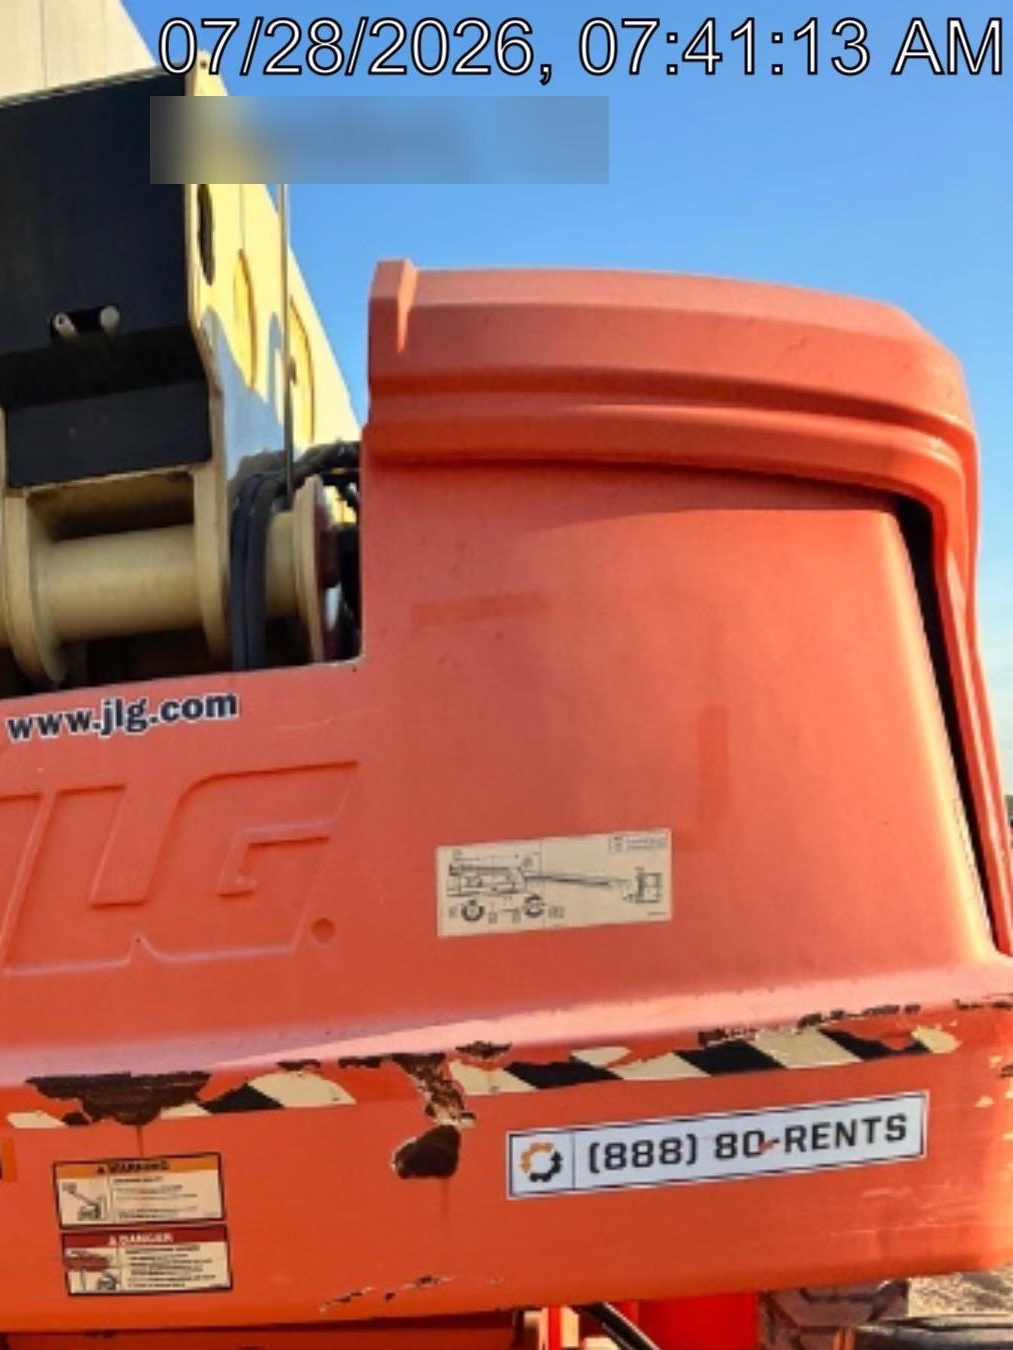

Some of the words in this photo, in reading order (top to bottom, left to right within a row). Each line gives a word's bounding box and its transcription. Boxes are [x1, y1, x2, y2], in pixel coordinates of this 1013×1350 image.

[6, 693, 239, 742] www.jlg.com
[588, 1133, 697, 1174] (888)
[714, 1113, 908, 1160] 80-RENTS
[108, 1160, 171, 1174] WARNING
[118, 1232, 174, 1245] DANGER
